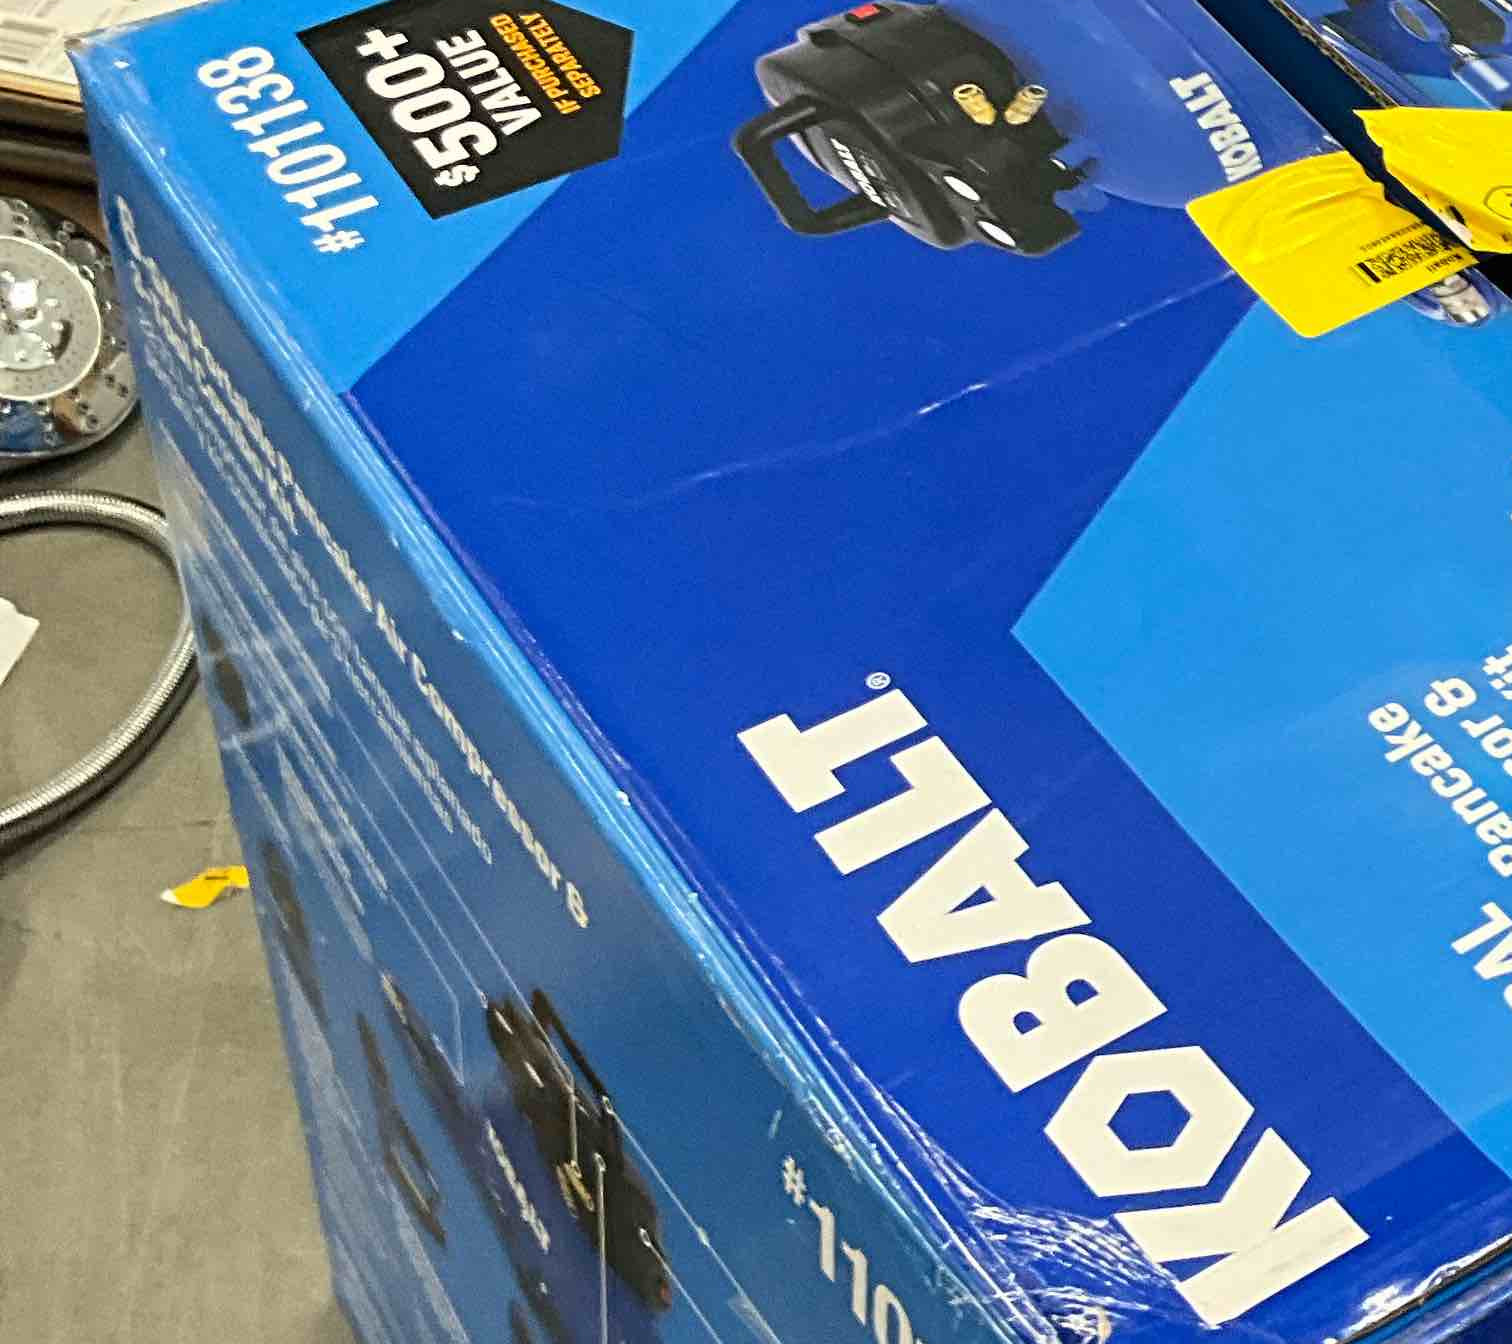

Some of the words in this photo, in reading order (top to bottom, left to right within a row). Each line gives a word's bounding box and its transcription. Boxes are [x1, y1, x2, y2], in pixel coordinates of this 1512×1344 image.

[355, 27, 499, 190] $500+
[435, 28, 543, 136] VALUE
[488, 13, 569, 102] PURCHASED
[519, 11, 602, 99] SEPARATELY
[197, 45, 380, 253] #1101138
[1168, 70, 1264, 183] KOBALT
[1423, 676, 1479, 718] &
[406, 647, 566, 893] Compressor
[737, 689, 1370, 1329] KOBALT
